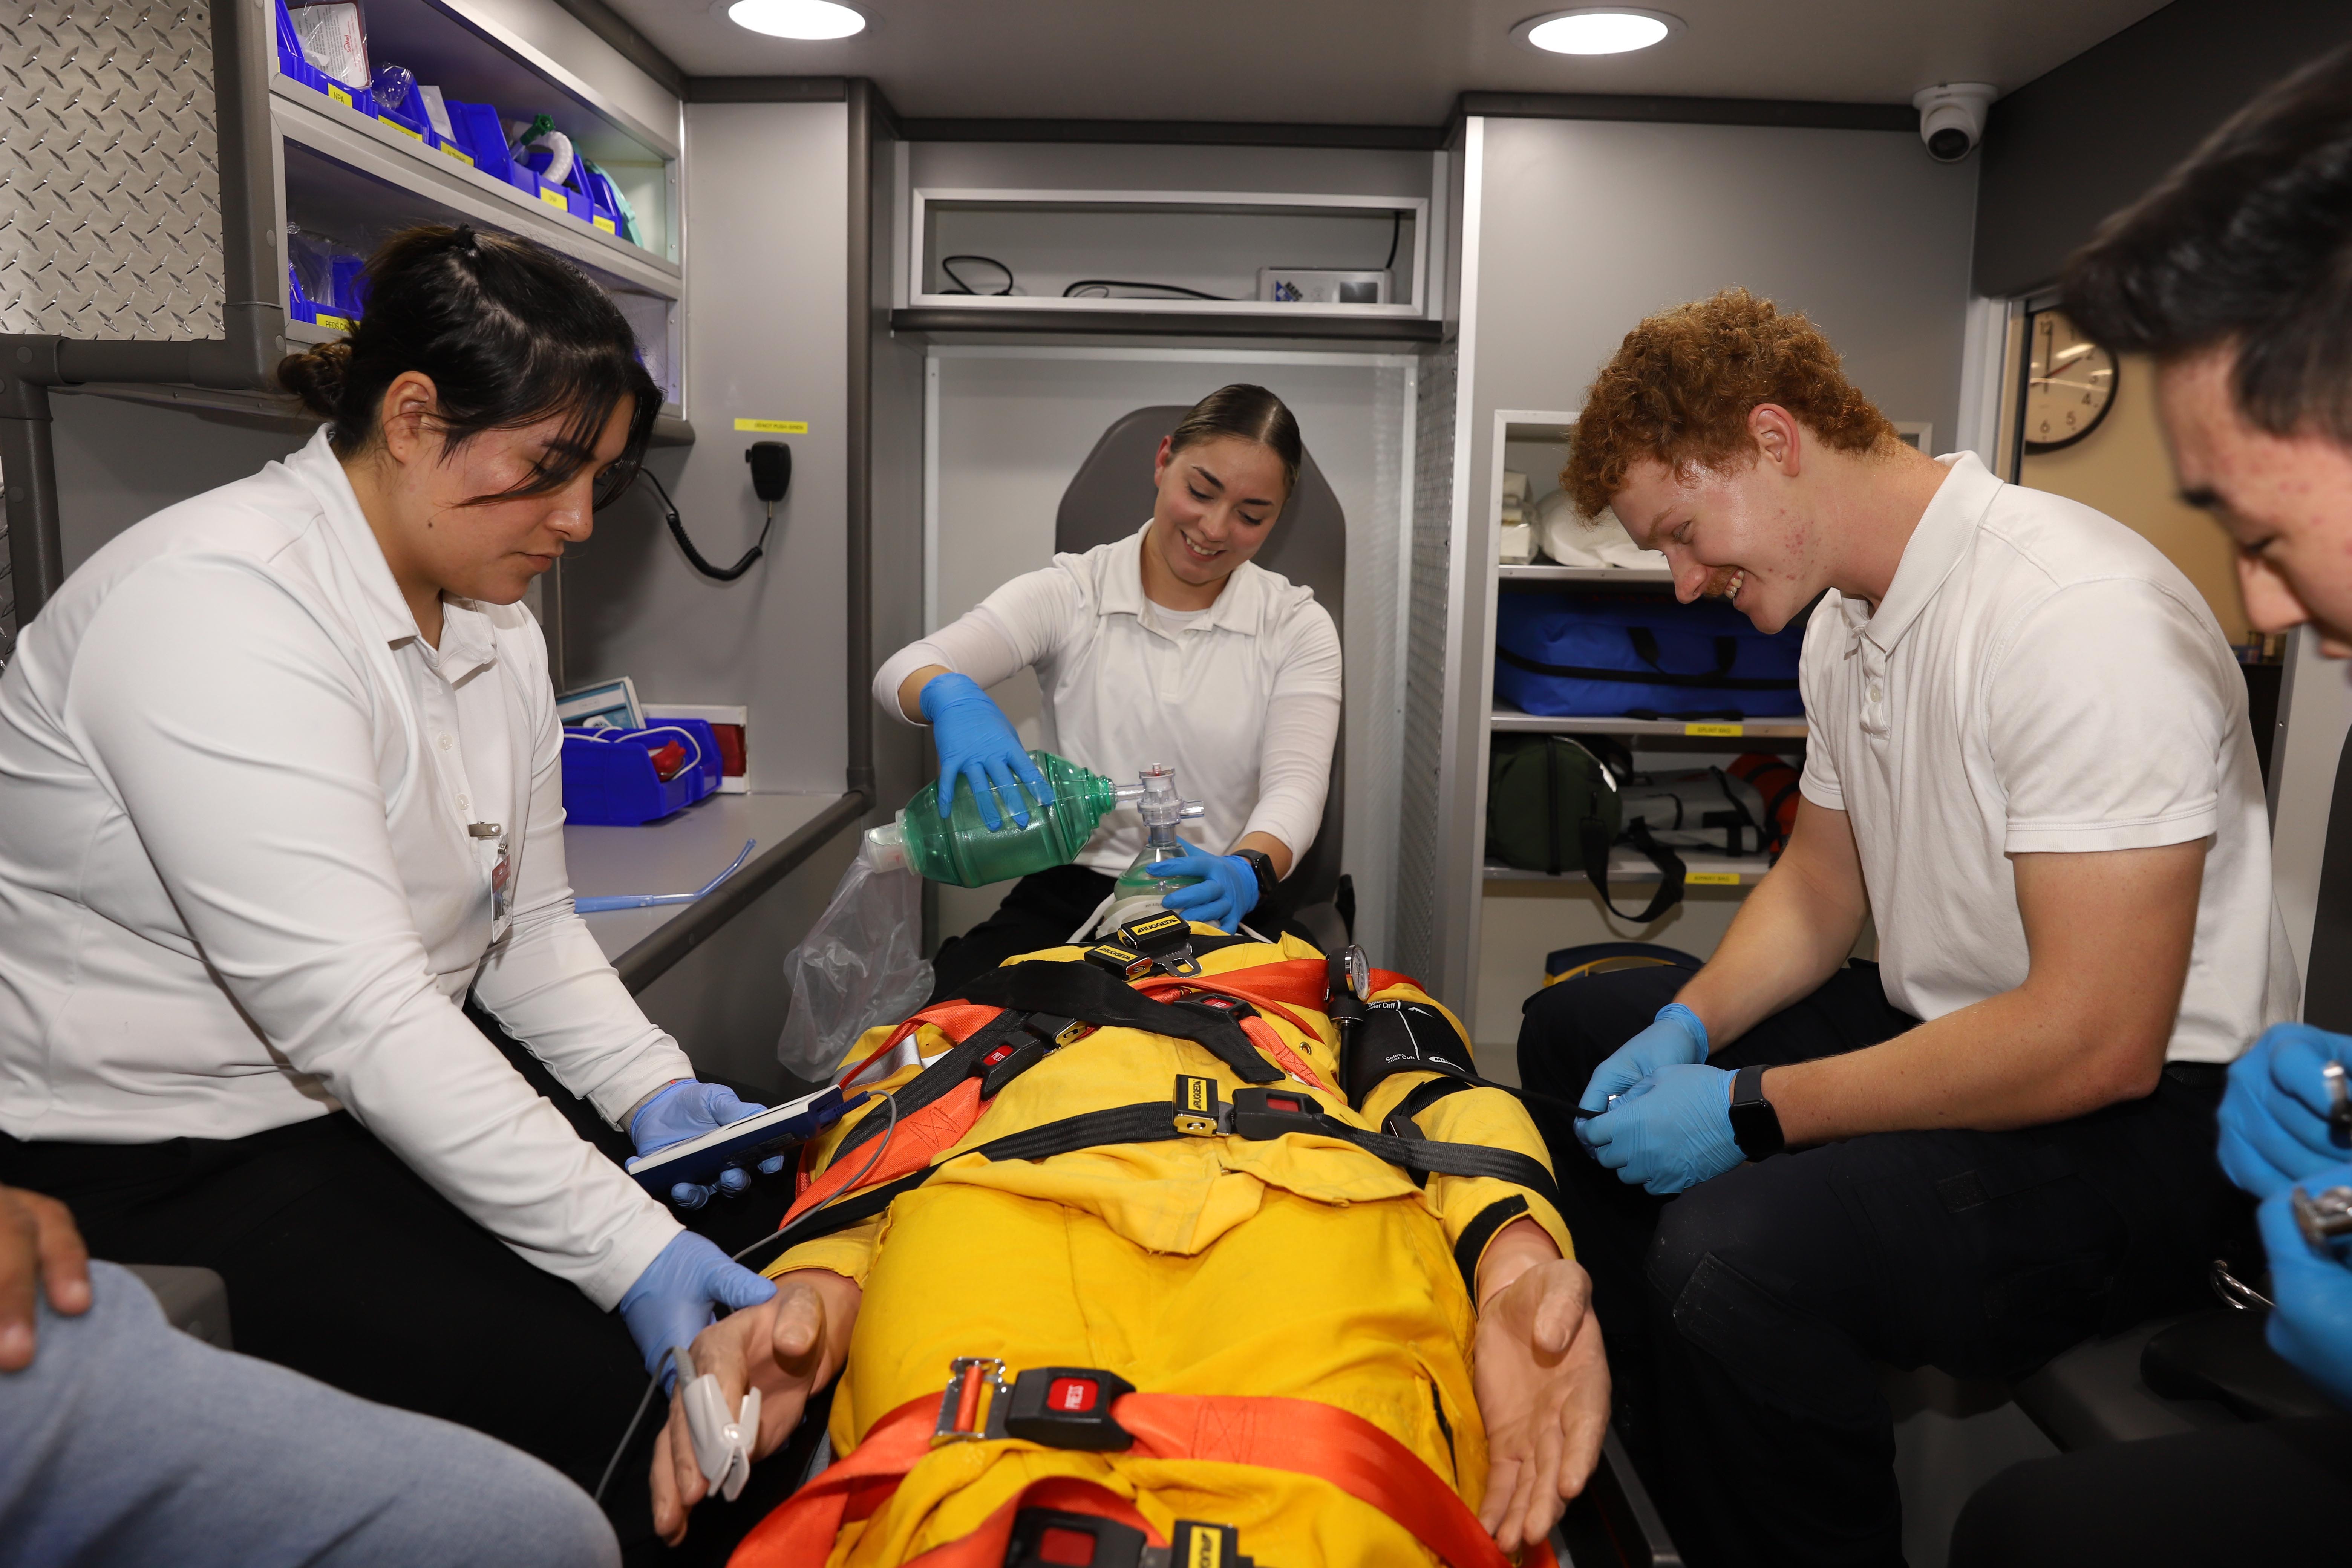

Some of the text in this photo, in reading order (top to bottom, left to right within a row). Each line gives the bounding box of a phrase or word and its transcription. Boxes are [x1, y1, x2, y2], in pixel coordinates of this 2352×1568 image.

[343, 34, 352, 53] SunMed
[334, 92, 345, 104] NPA
[2081, 392, 2093, 405] 4
[2039, 419, 2051, 434] 6
[1140, 919, 1173, 932] RUGGED
[1102, 948, 1129, 959] RUGGED
[991, 1052, 1005, 1062] PRESS
[1193, 1083, 1201, 1107] RUGGED
[1064, 1384, 1084, 1410] PRESS
